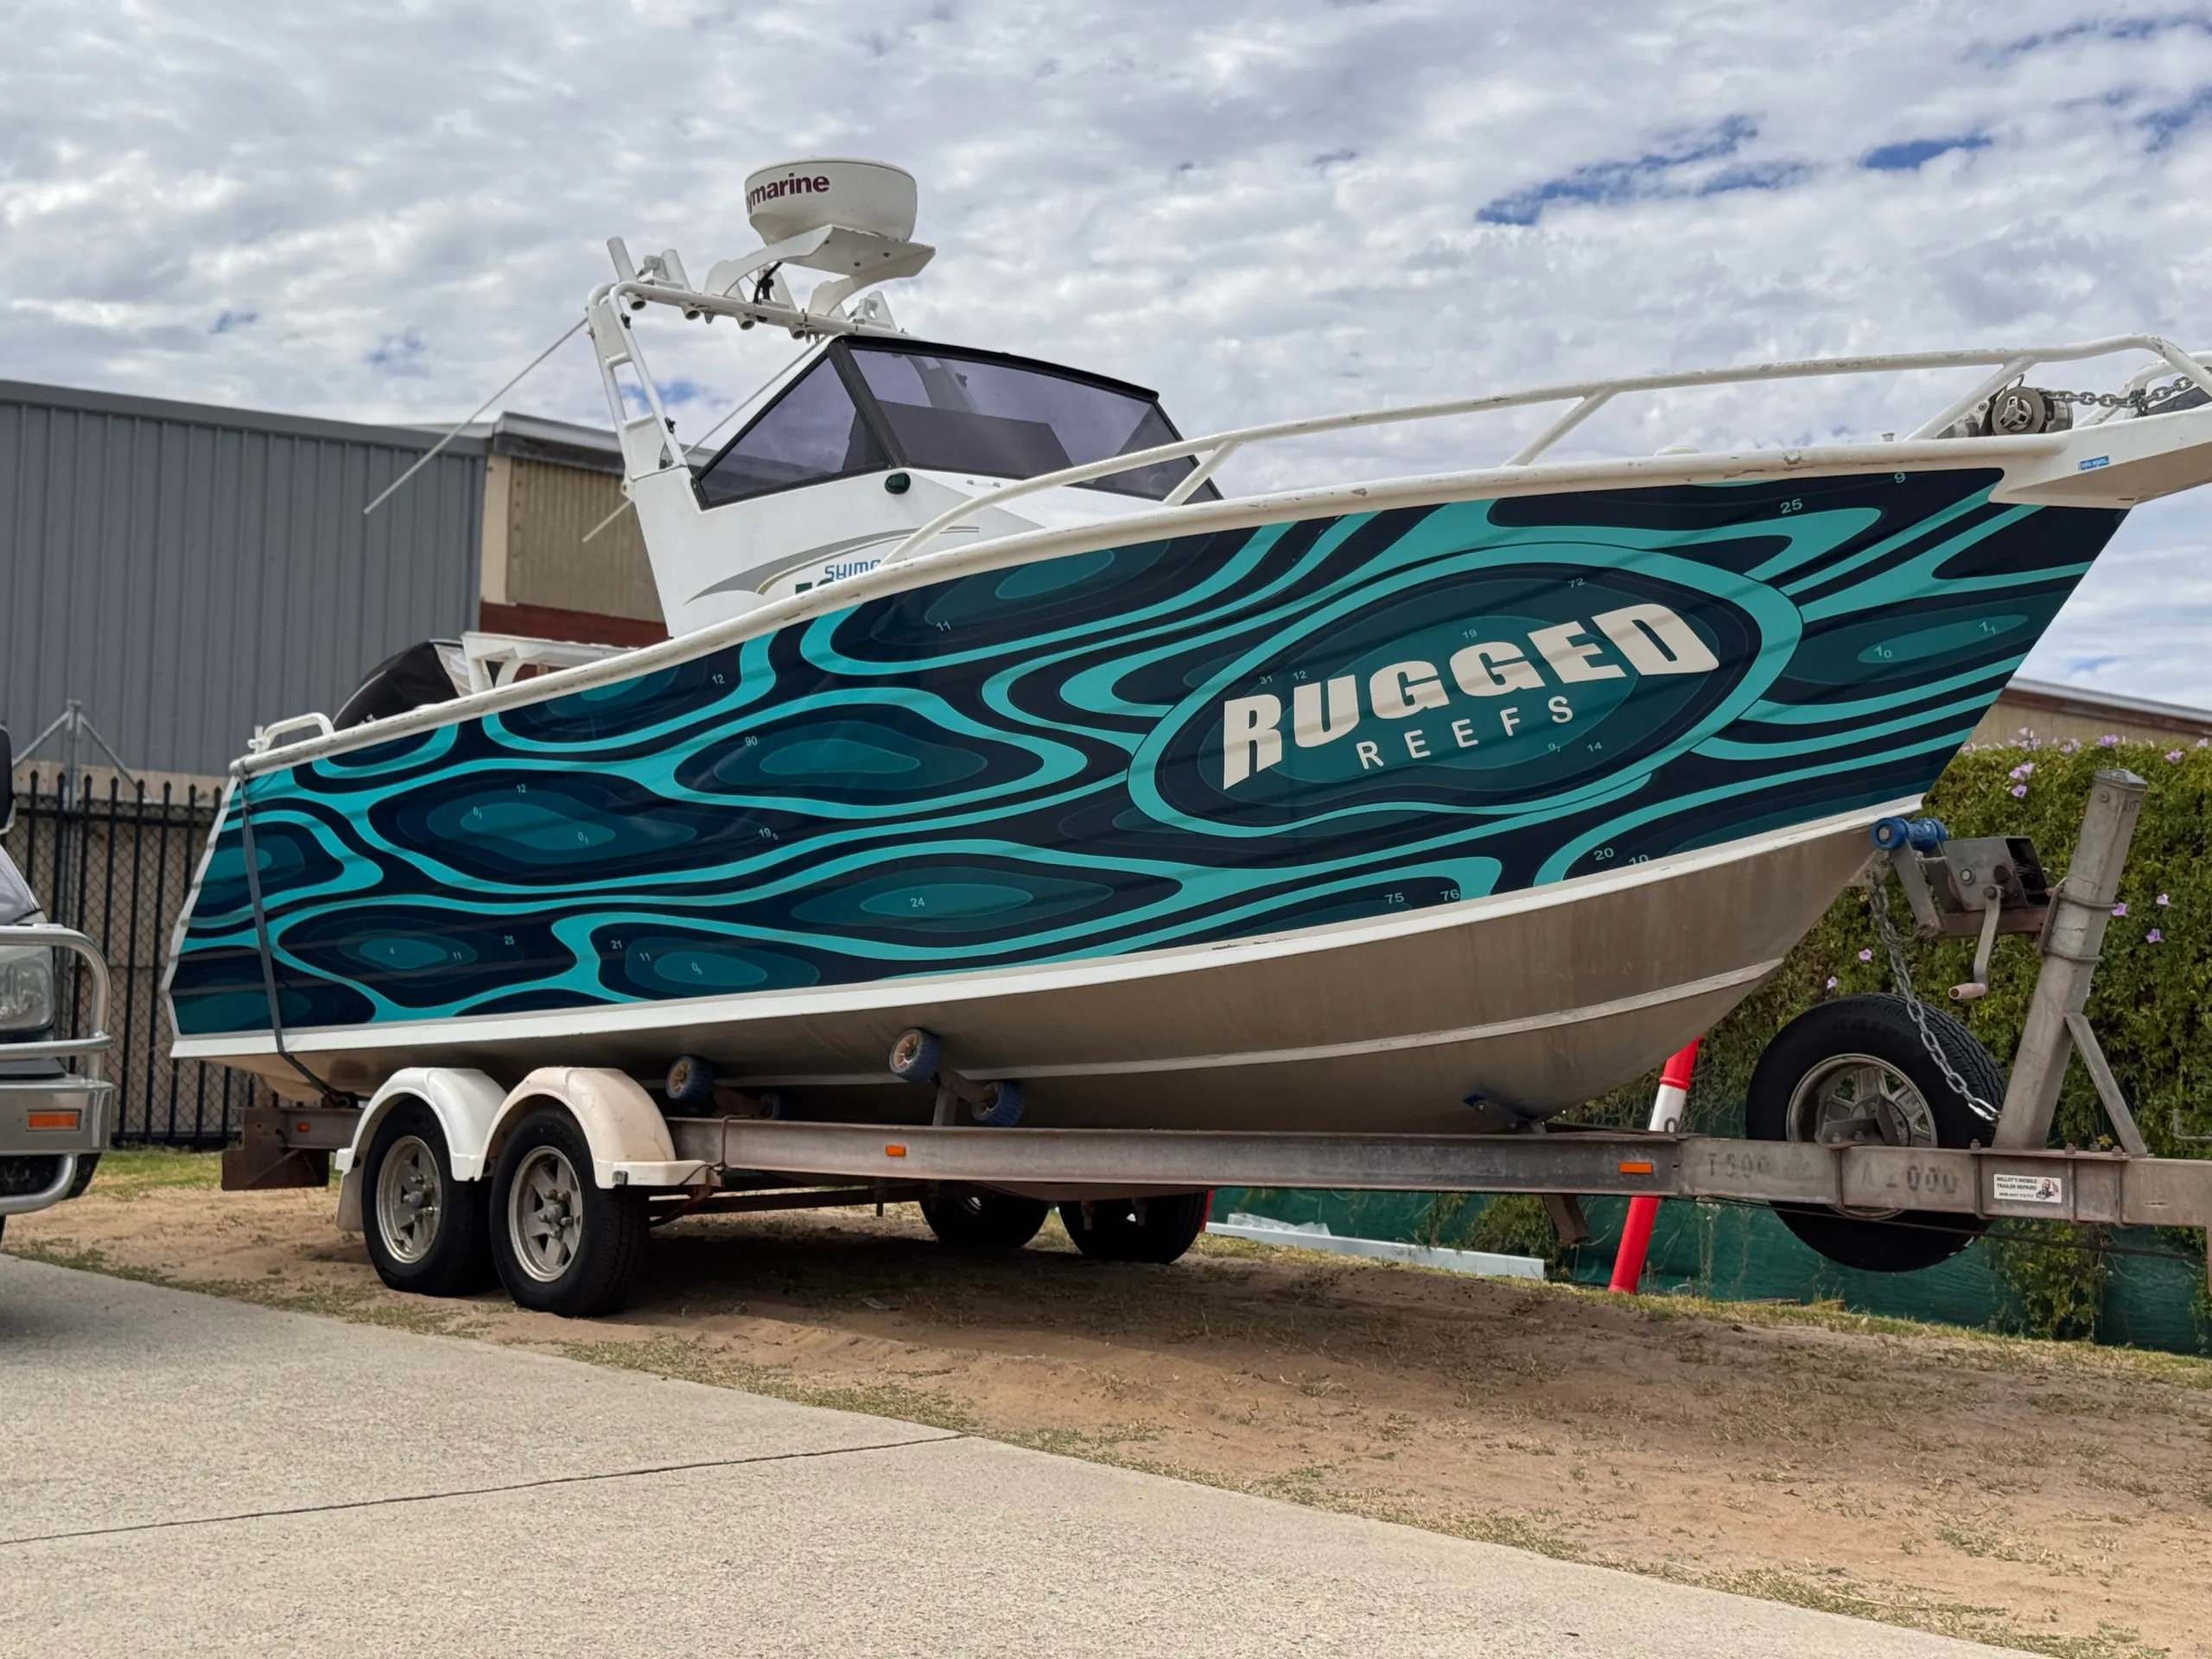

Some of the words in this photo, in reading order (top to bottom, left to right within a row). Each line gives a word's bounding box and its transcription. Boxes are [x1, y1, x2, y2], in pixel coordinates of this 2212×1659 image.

[1780, 499, 1802, 514] 25
[1567, 578, 1585, 588] 72
[937, 620, 951, 632] 11
[1463, 630, 1478, 639] 19
[711, 674, 725, 684] 12
[1259, 675, 1273, 684] 31
[1294, 671, 1306, 681] 12
[1224, 604, 1719, 790] RUGGED
[1357, 696, 1573, 769] REEFS
[745, 736, 758, 747] 90
[1586, 741, 1603, 752] 14
[517, 784, 527, 793] 12
[1593, 848, 1614, 861] 20
[1384, 893, 1404, 905] 75
[1440, 889, 1459, 901] 76
[910, 897, 925, 908] 24
[611, 939, 623, 950] 21
[453, 951, 462, 961] 11
[639, 952, 651, 962] 11
